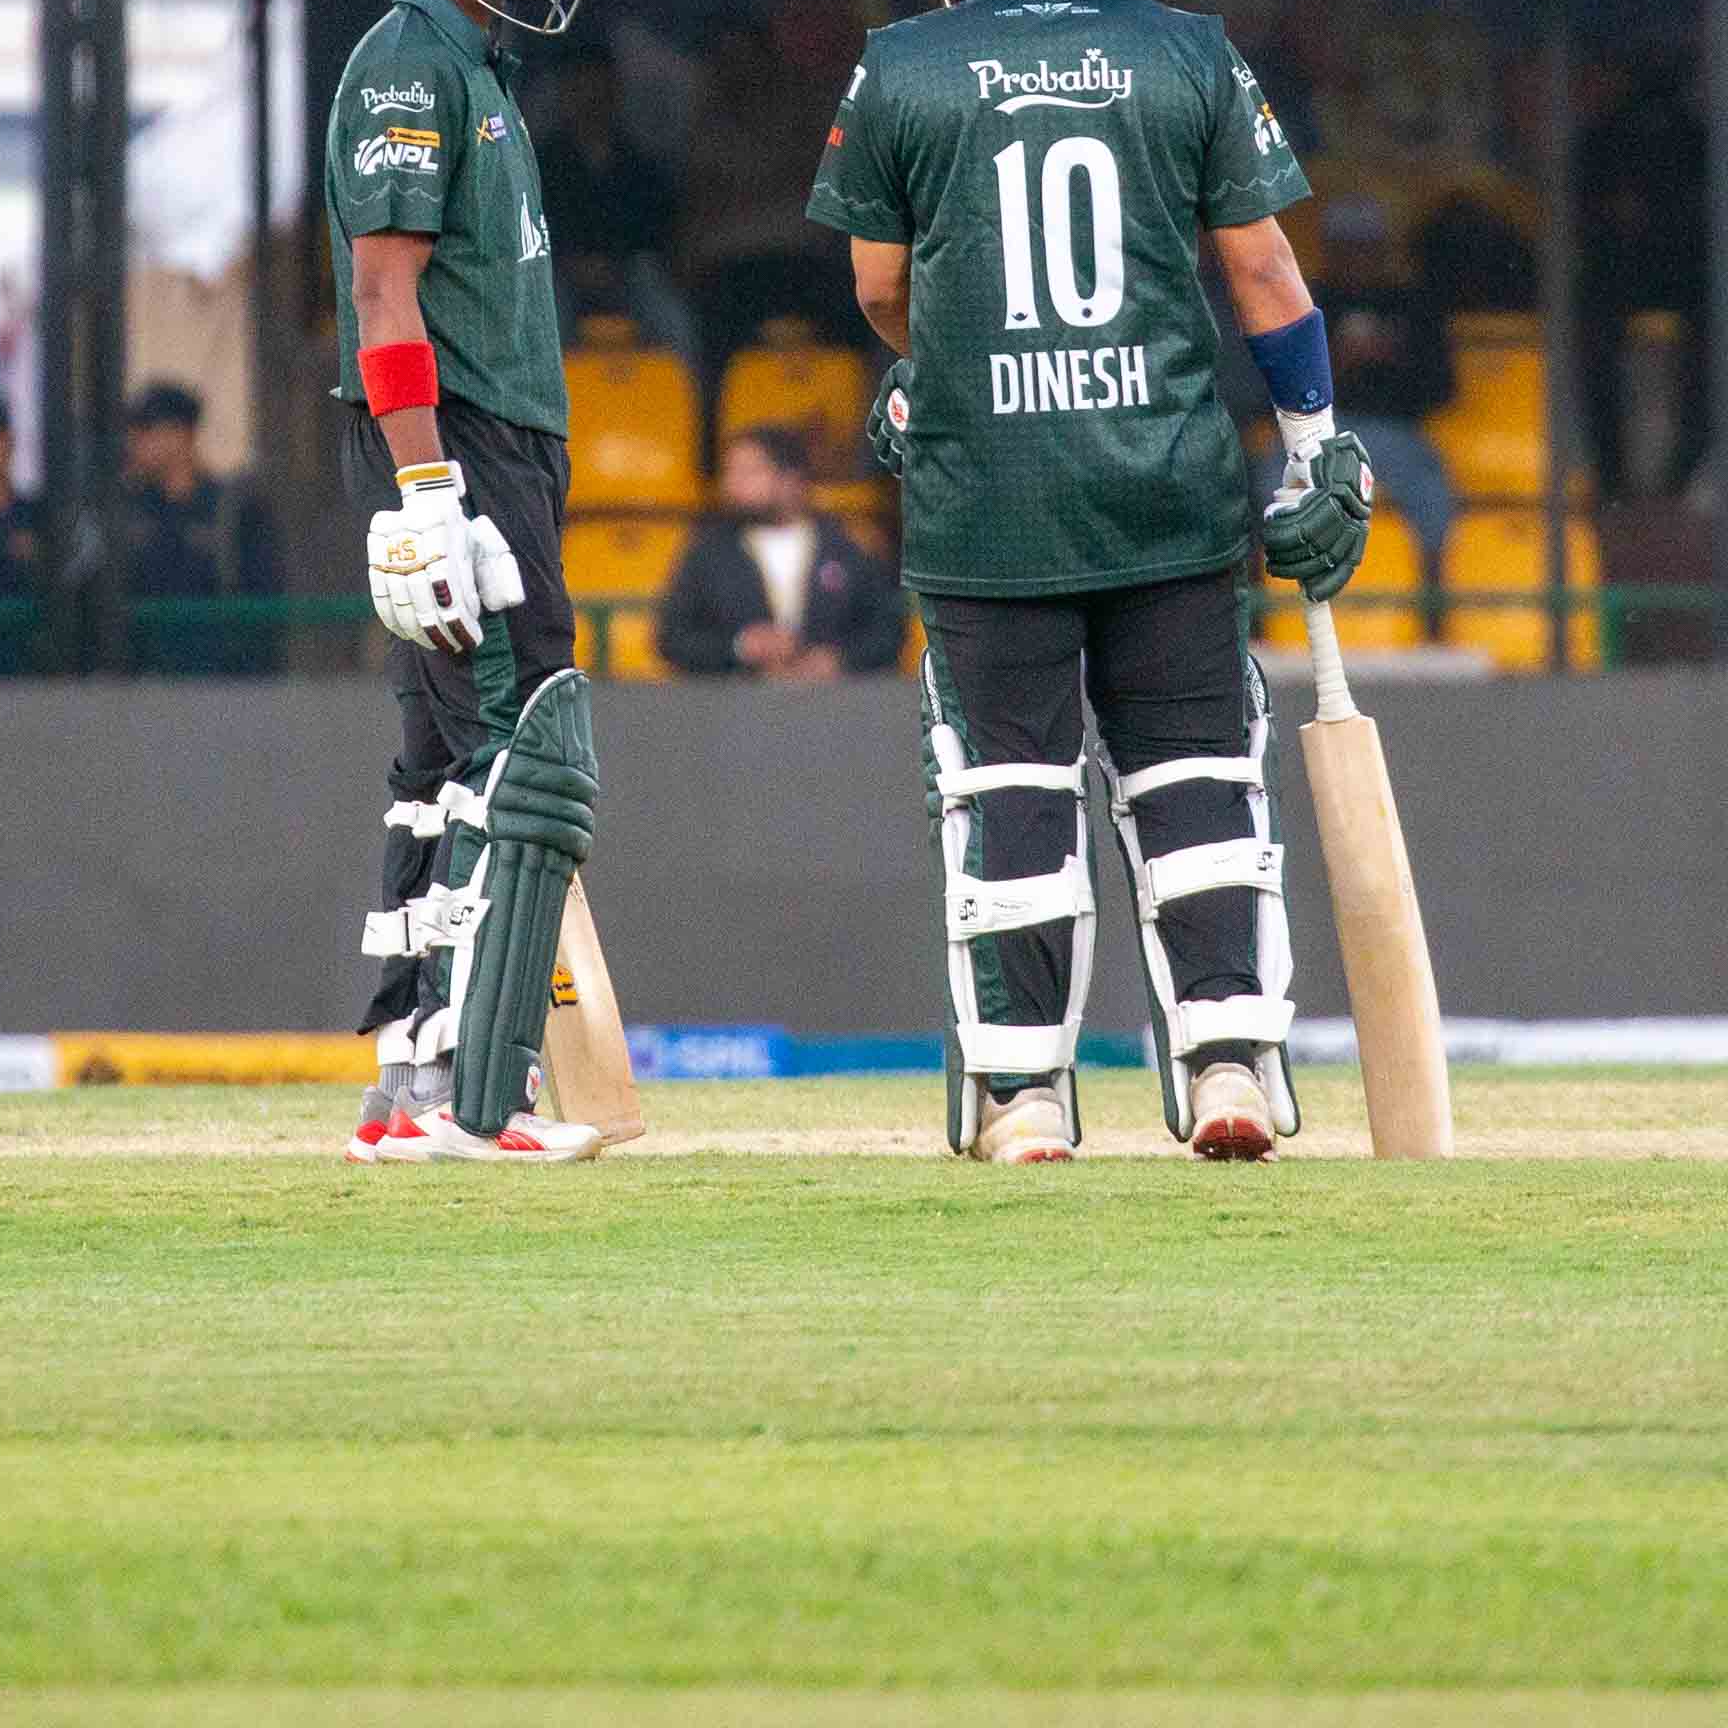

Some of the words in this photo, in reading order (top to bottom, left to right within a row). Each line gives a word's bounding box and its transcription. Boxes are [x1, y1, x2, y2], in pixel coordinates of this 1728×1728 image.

[361, 81, 436, 115] Probably
[968, 54, 1134, 115] Probably
[383, 142, 440, 172] NPL
[992, 136, 1125, 330] 10
[989, 345, 1150, 415] DINESH
